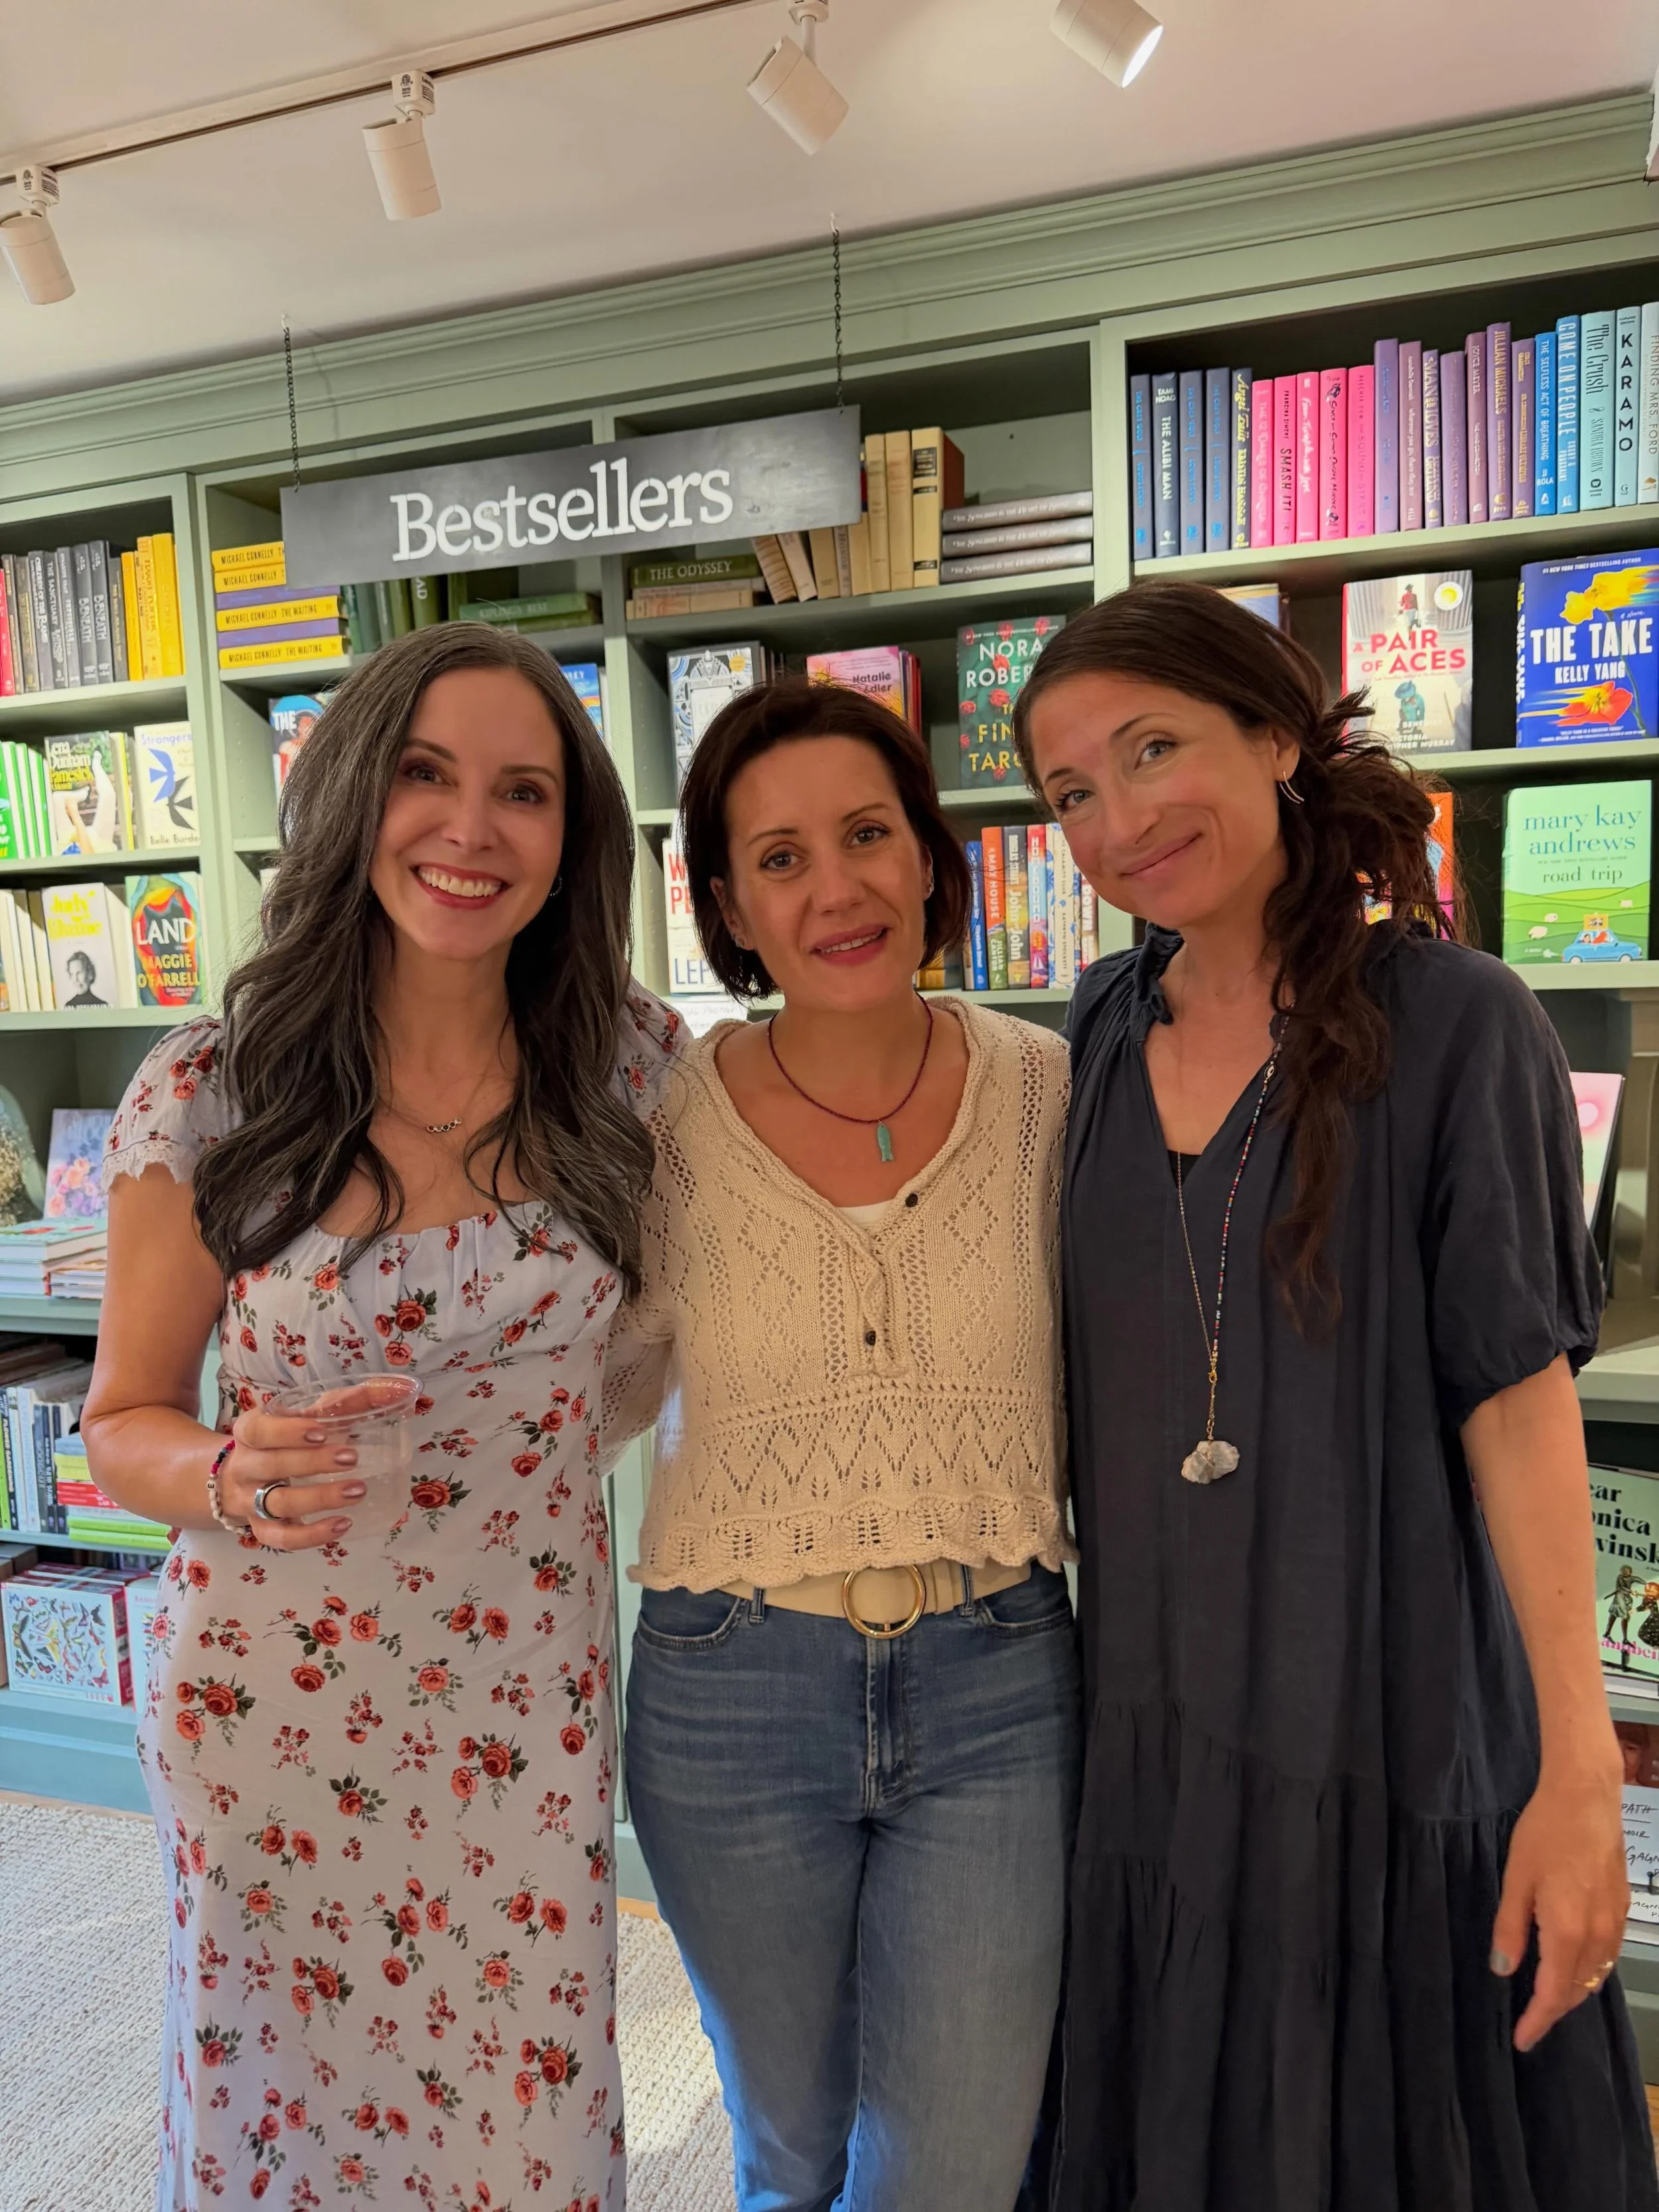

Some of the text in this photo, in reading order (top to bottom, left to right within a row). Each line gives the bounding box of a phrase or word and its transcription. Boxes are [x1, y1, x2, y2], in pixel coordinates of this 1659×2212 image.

[1494, 331, 1506, 414] JILLIAN MICHAELS
[1586, 325, 1610, 394] The Crush
[1425, 361, 1437, 396] MAN
[1540, 358, 1550, 389] SELFLESS
[1558, 323, 1576, 435] COME ON PEOPLE
[1157, 388, 1174, 396] TAMI
[1234, 374, 1250, 410] Angel
[1541, 392, 1550, 406] ACT
[1619, 332, 1634, 452] KARAMO
[1648, 335, 1659, 454] FINDING MRS. FORD
[1258, 402, 1267, 418] THE
[1161, 416, 1172, 500] THE ALIBI MAN
[1591, 419, 1603, 472] SANDRA BROWN
[1259, 469, 1267, 479] OF
[1280, 449, 1291, 489] SMASH
[1537, 477, 1553, 486] BOLA
[390, 457, 734, 562] Bestsellers
[1281, 495, 1291, 511] IT!
[221, 549, 273, 564] MICHAEL CONNELLY
[1590, 559, 1621, 569] BESTSELLING
[224, 571, 277, 586] MICHAEL CONNELLY
[650, 561, 733, 581] THE ODYSSEY
[48, 579, 58, 625] SANCTUARY
[226, 605, 318, 624] MICHAEL CONNELLY THE WAITING
[79, 597, 92, 643] BENEATH
[94, 594, 107, 640] BENEATH
[229, 644, 323, 662] MICHAEL CONNELLY THE WAITING
[979, 638, 1043, 662] NORA
[1353, 628, 1438, 654] A PAIR
[1530, 617, 1653, 664] THE TAKE
[1362, 648, 1467, 674] OF ACES
[1555, 660, 1626, 684] KELLY YANG
[853, 672, 892, 684] Natalie
[966, 664, 1033, 688] ROBER
[271, 710, 297, 731] THE
[1524, 804, 1642, 833] mary kay
[1529, 832, 1636, 855] andrews
[1543, 865, 1623, 884] road trip
[989, 881, 999, 919] HOUSE
[1009, 889, 1023, 922] John
[1082, 884, 1093, 931] DOWN
[136, 917, 197, 945] LAND
[1009, 928, 1023, 960] John
[1592, 1509, 1651, 1536] nica
